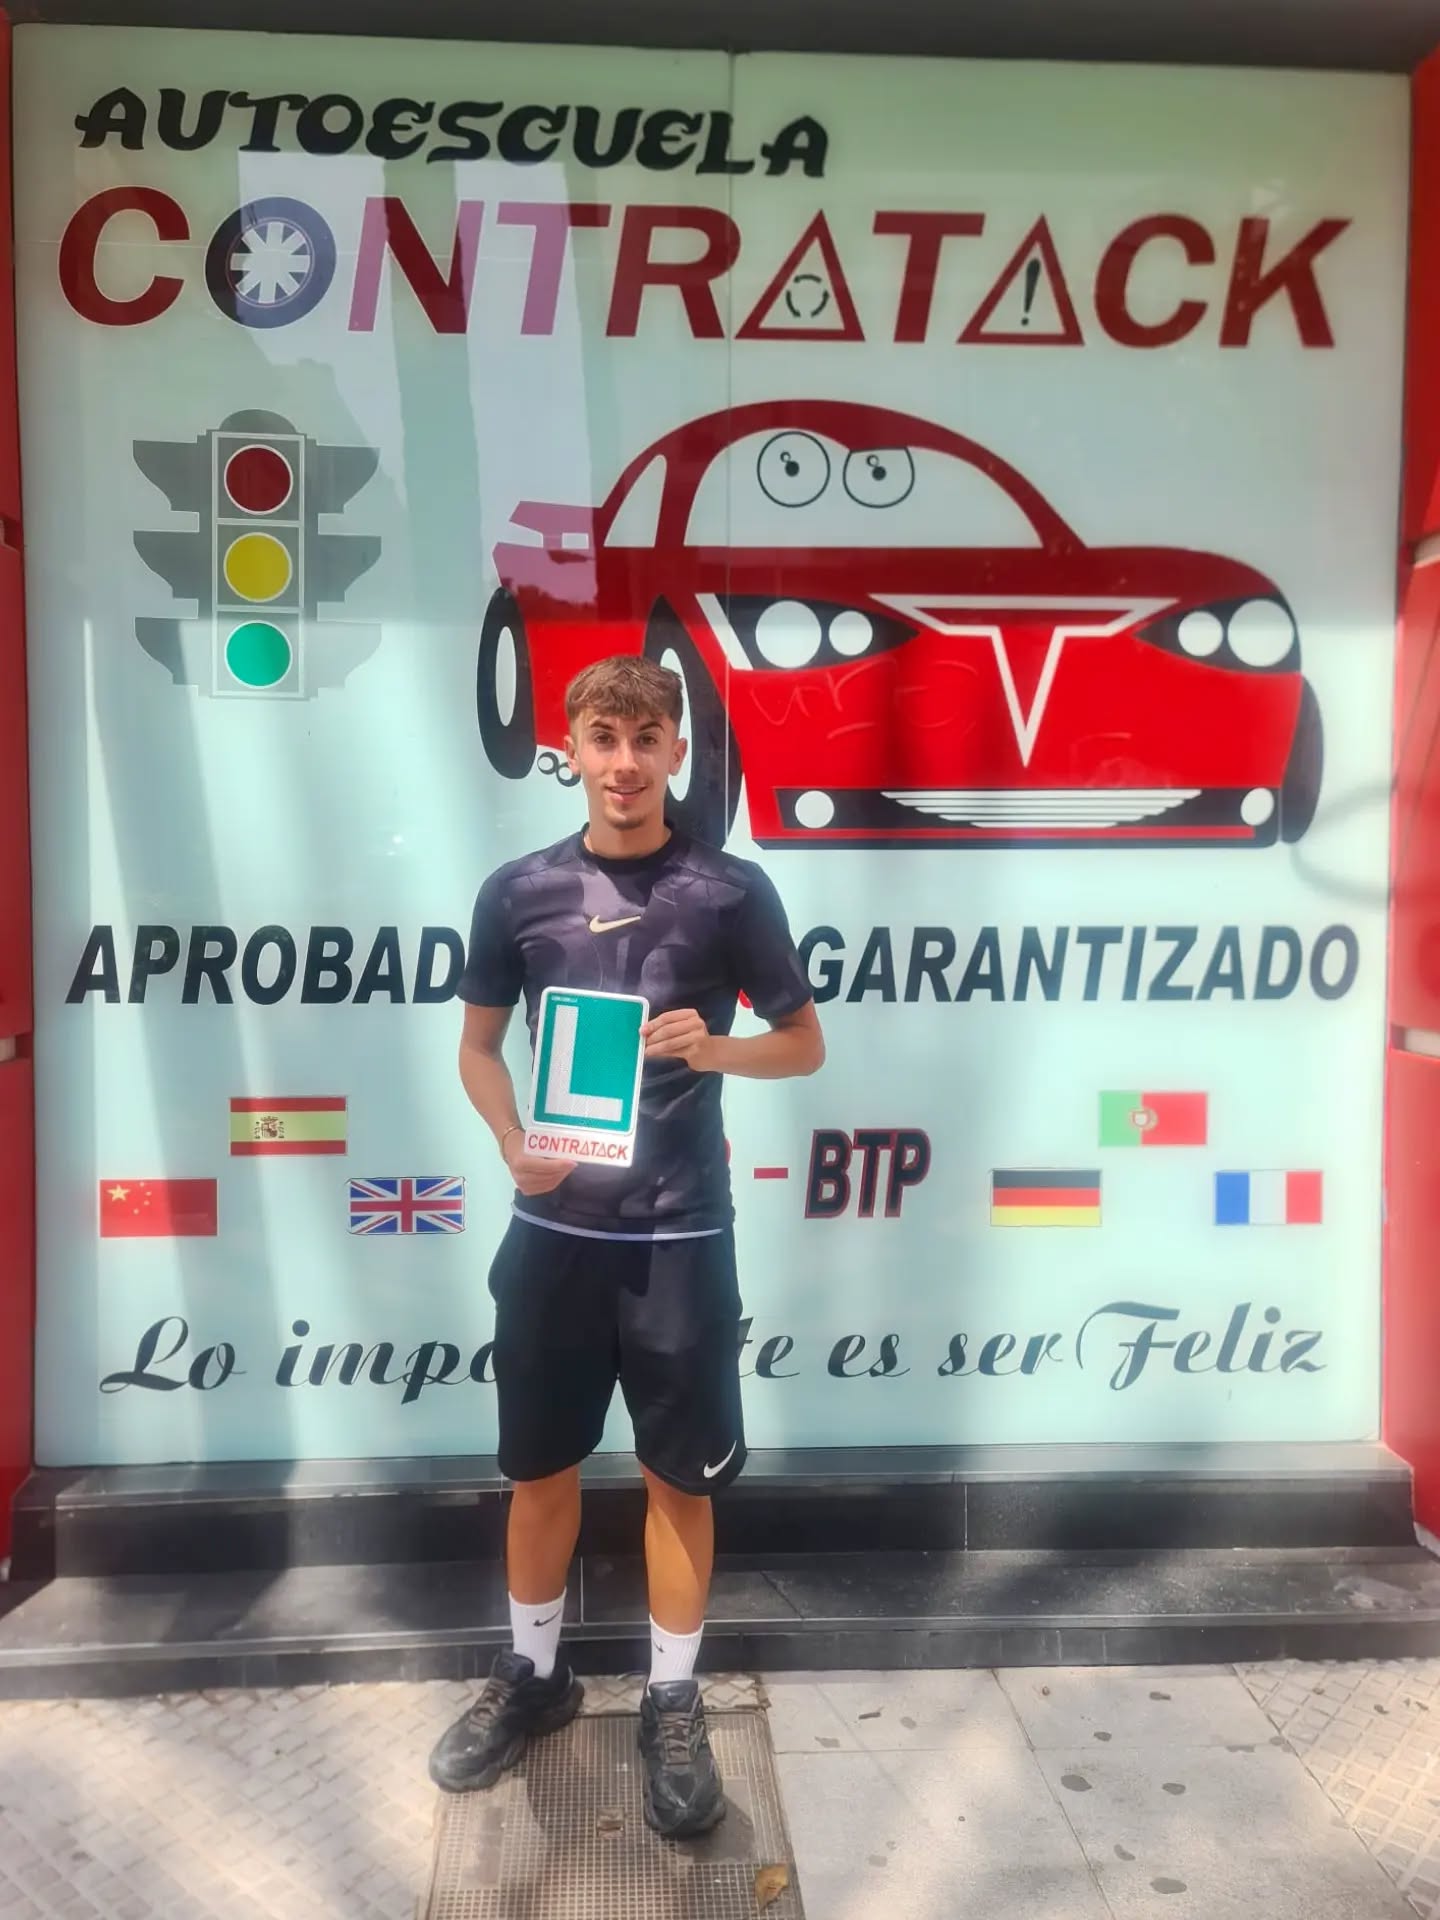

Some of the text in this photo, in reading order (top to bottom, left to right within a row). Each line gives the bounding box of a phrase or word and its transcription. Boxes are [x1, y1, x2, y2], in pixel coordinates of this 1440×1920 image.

[74, 86, 829, 178] AUTOESCUELA
[65, 923, 1361, 1005] APROBAD GARANTIZADO
[544, 1004, 624, 1122] L
[528, 1134, 628, 1160] CONTRATACK
[804, 1128, 932, 1219] BTP
[99, 1316, 247, 1394] Lo
[827, 1332, 911, 1379] es
[937, 1331, 1064, 1378] ser
[1075, 1301, 1327, 1391] Feliz
